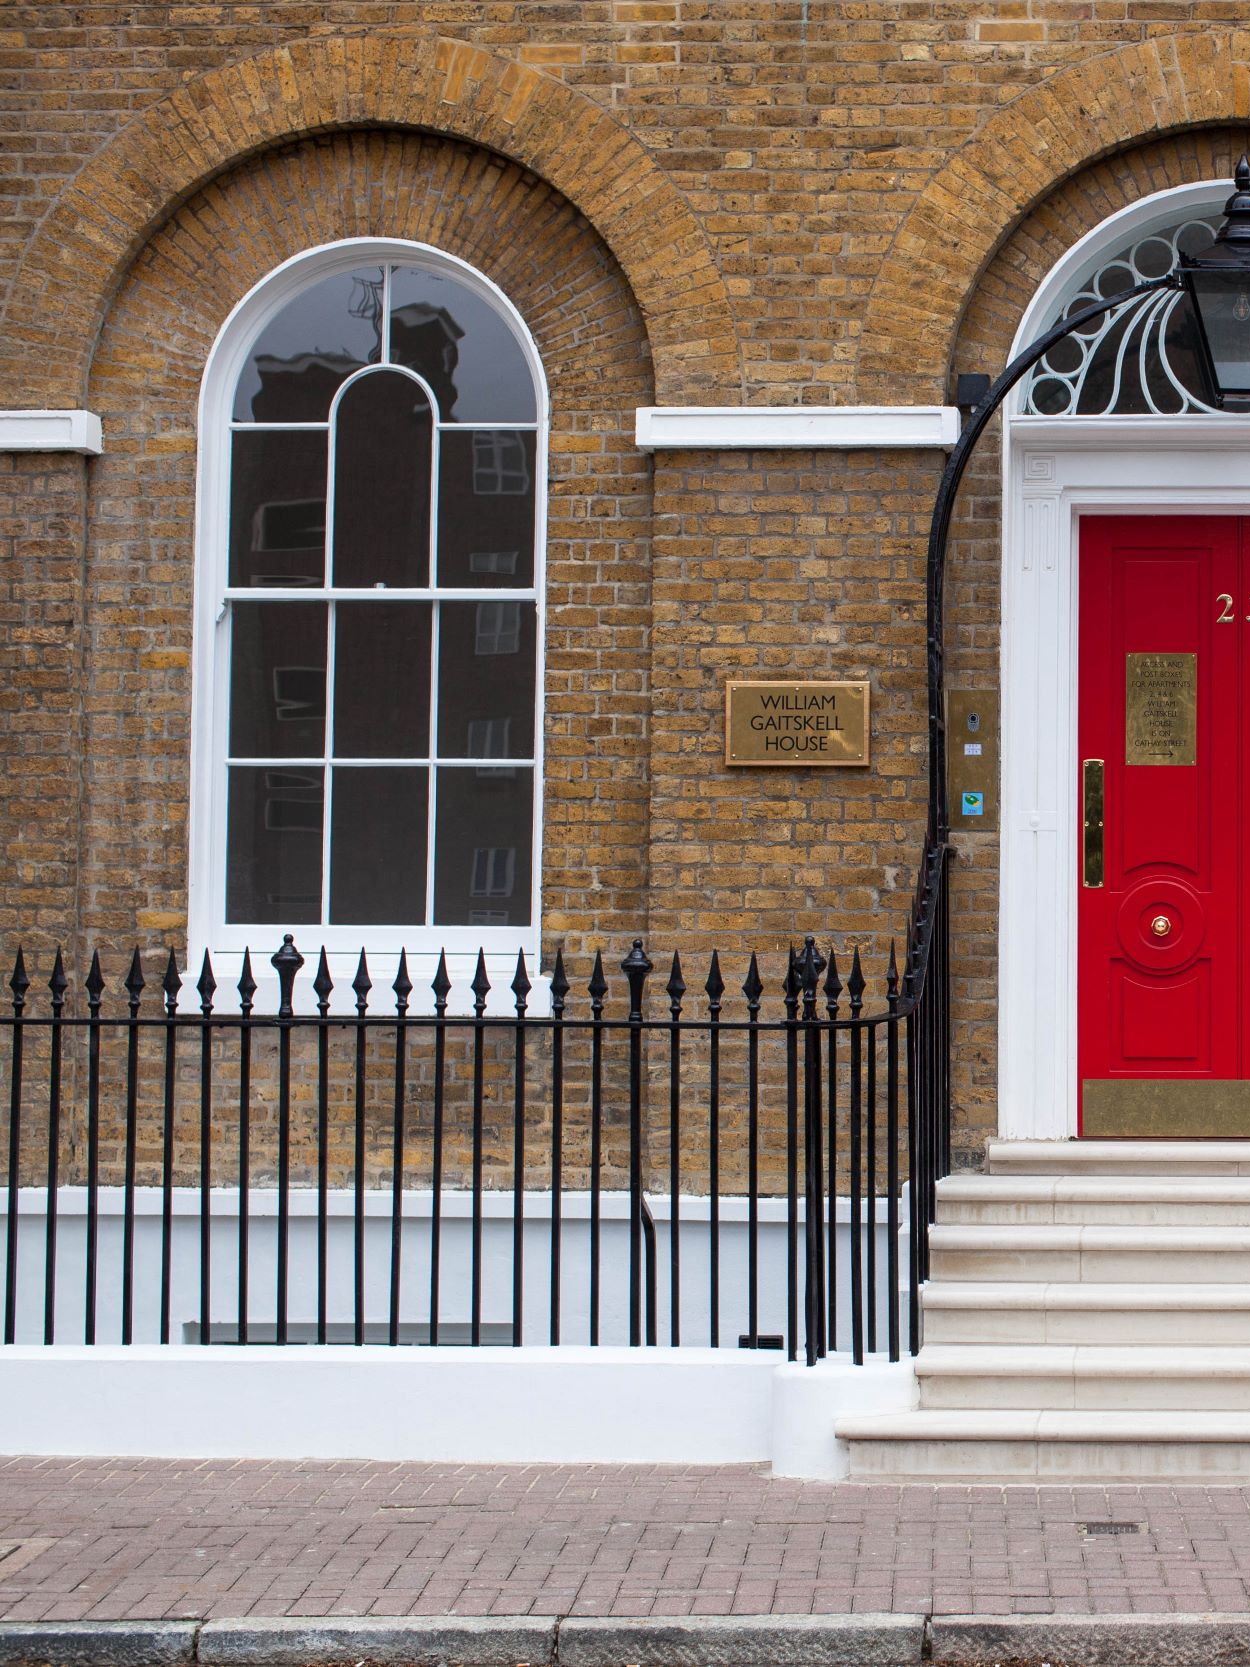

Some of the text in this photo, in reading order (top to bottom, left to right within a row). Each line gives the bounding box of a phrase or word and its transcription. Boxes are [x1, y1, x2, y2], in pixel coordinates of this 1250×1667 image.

[1131, 680, 1191, 688] FOR APARTMENTS
[759, 695, 836, 711] WILLIAM
[1147, 700, 1176, 708] WILLIAM
[1143, 710, 1177, 718] GAITSKELL
[750, 715, 844, 731] GAITSKELL
[765, 735, 829, 751] HOUSE
